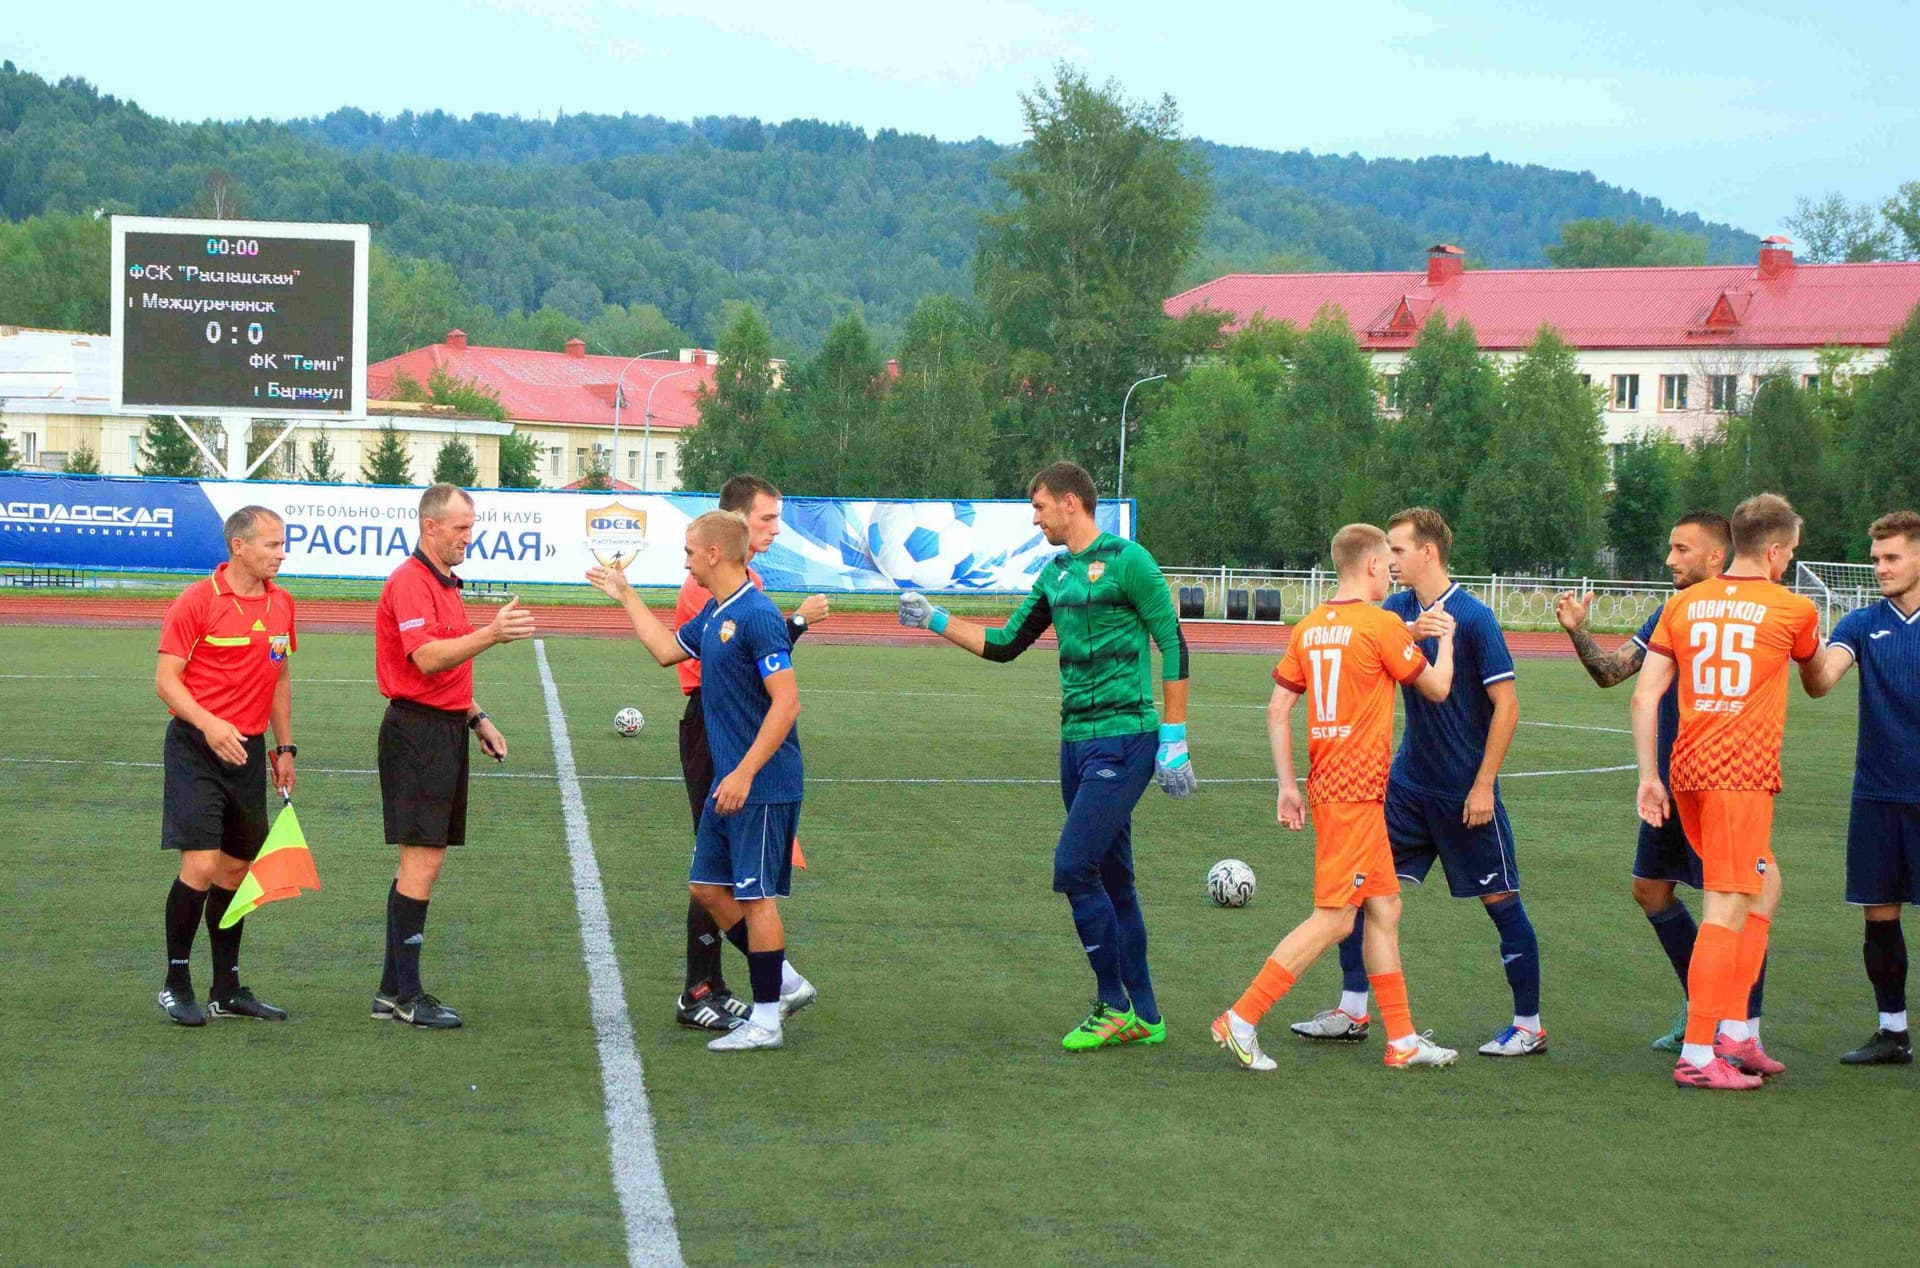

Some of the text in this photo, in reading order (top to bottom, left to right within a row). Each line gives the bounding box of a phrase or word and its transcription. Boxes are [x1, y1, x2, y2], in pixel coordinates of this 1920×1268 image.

[206, 239, 259, 255] 00:00
[129, 264, 173, 281] ФСК
[248, 353, 278, 369] ФК
[503, 511, 543, 524] КЛУБ
[590, 518, 642, 530] ФСК
[77, 528, 173, 538] КОМПАНИЯ
[1687, 600, 1768, 624] НОВИЧКОВ
[1689, 622, 1756, 697] 25
[1308, 649, 1342, 722] 17
